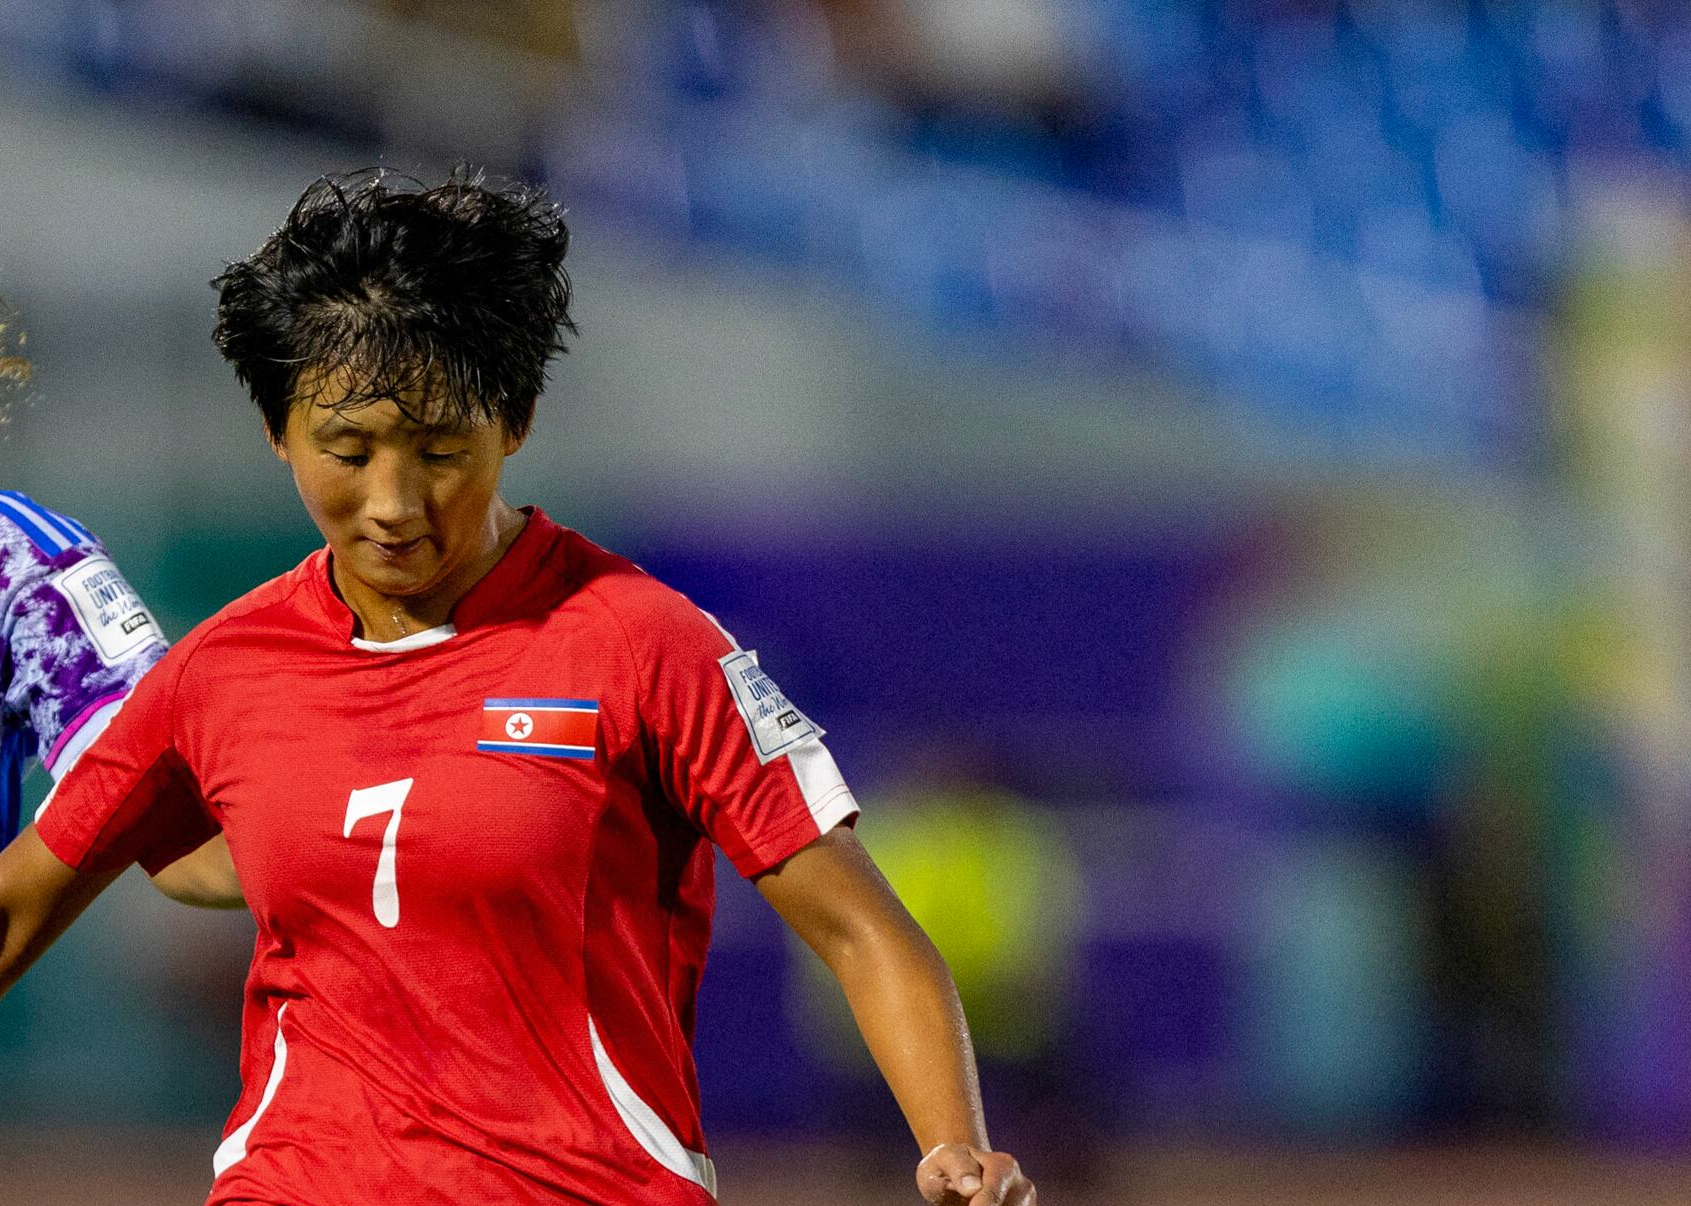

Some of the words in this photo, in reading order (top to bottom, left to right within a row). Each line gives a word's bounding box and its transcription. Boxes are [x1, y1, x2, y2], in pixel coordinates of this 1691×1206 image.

[98, 609, 118, 627] the
[123, 614, 148, 634] FIFA
[757, 701, 775, 719] the
[778, 711, 799, 727] FIFA
[343, 777, 414, 928] 7
